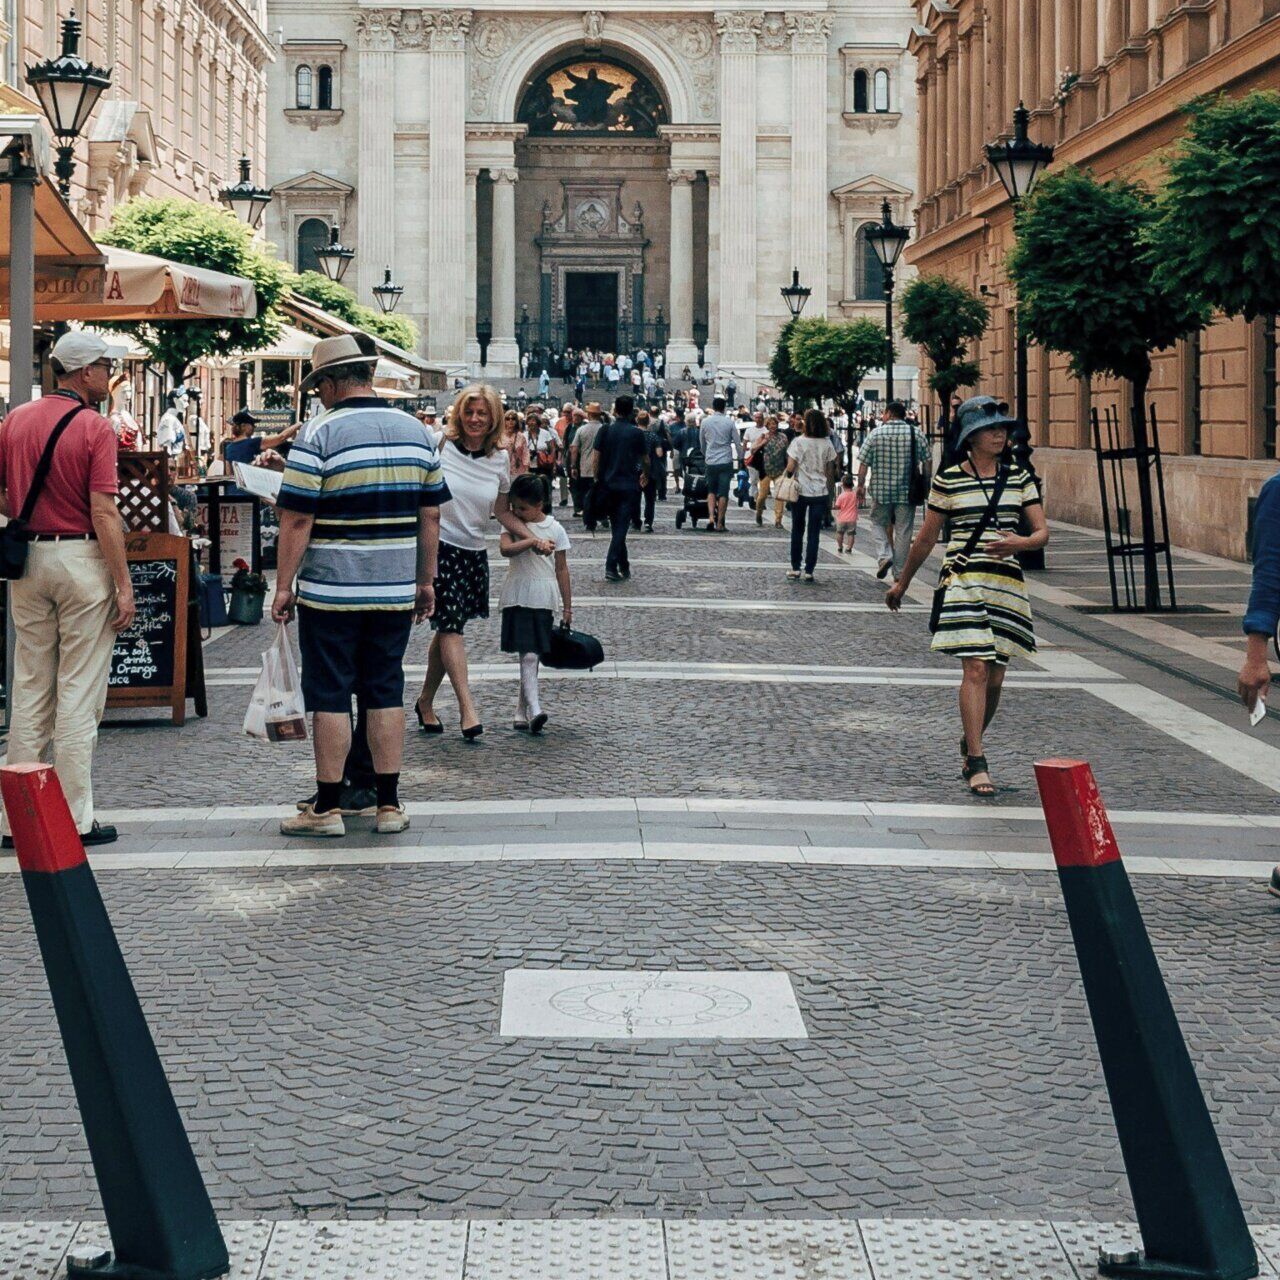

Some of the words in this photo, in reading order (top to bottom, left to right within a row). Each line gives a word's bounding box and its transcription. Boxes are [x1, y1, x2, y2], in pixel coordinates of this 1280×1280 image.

[112, 647, 129, 656] ola
[117, 663, 158, 679] Orange
[108, 676, 130, 685] uice
